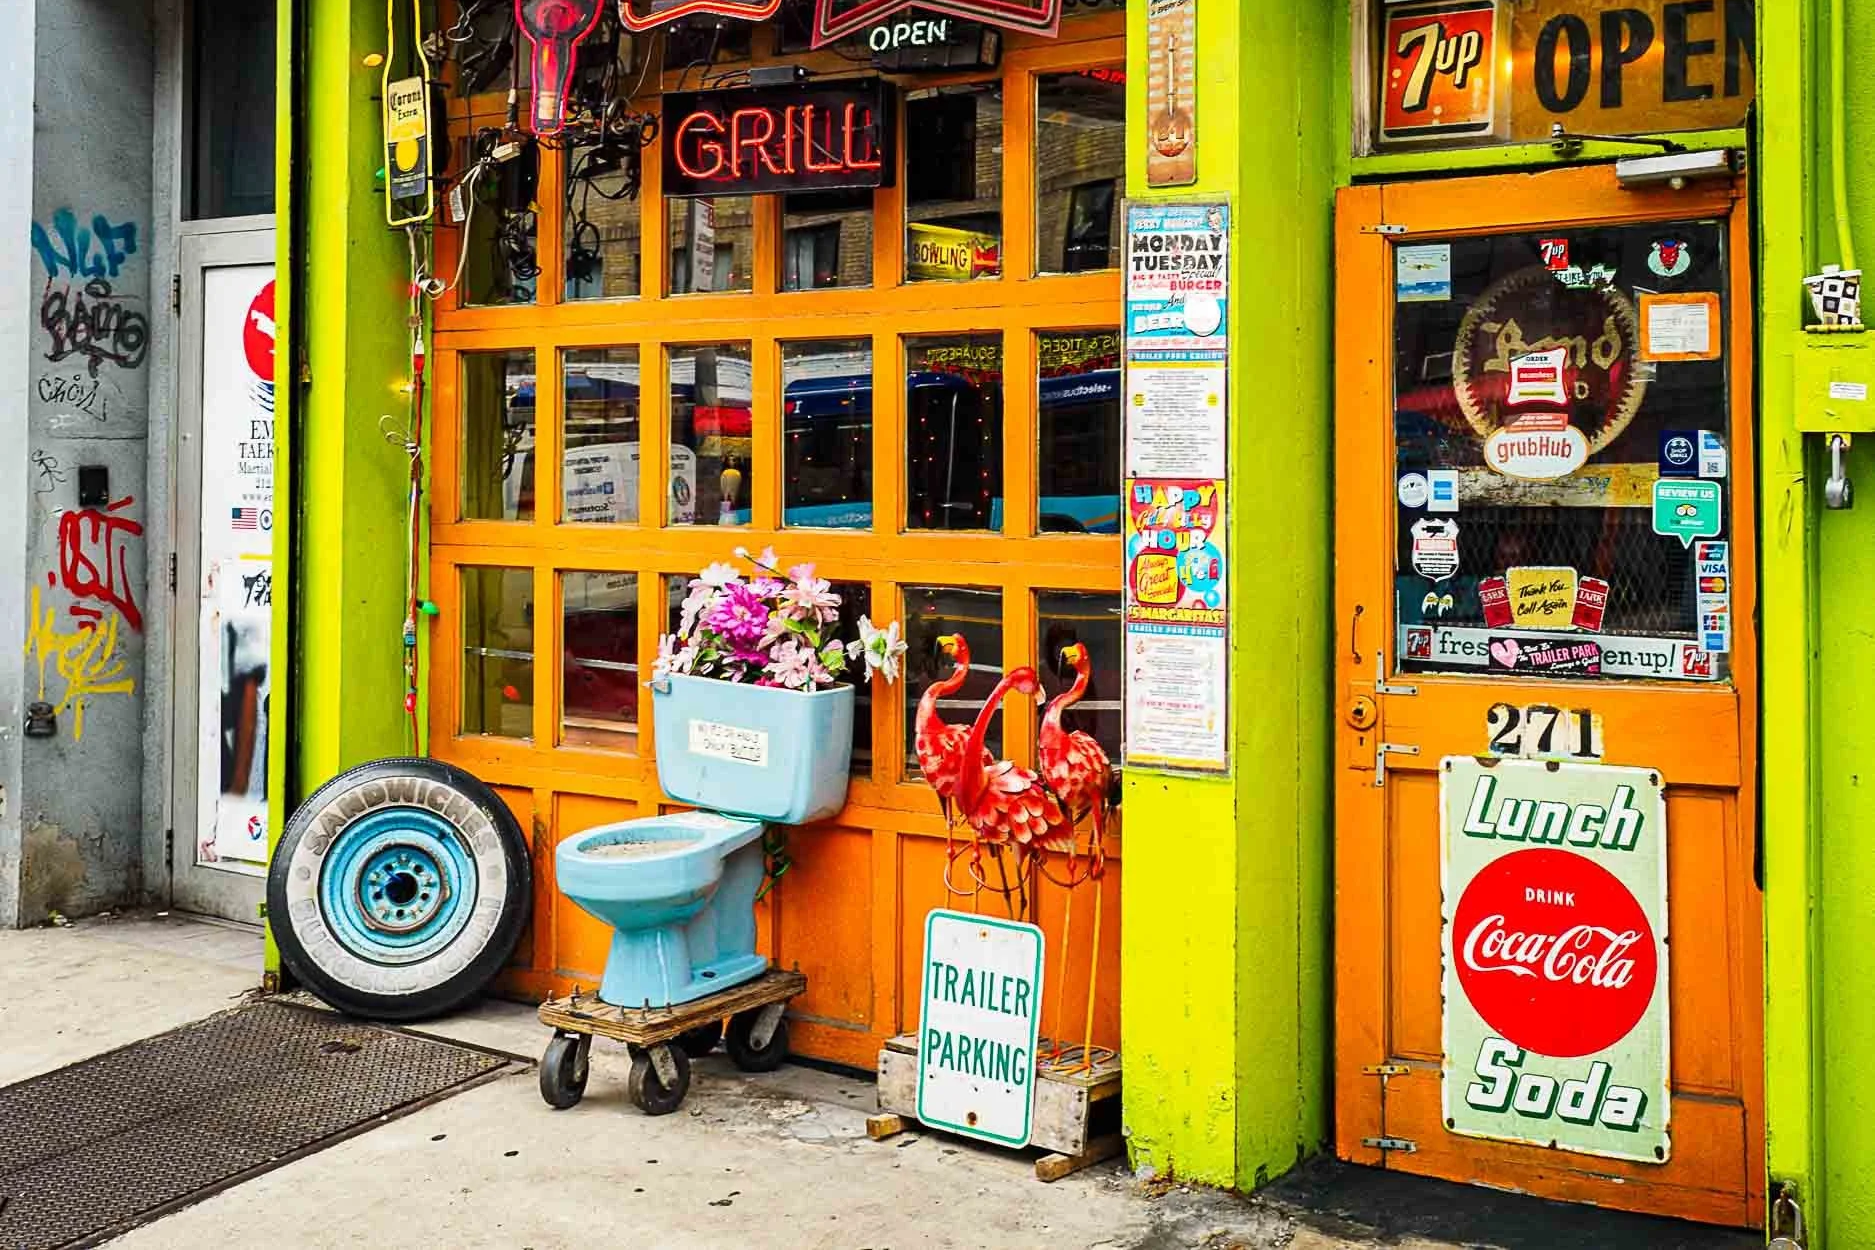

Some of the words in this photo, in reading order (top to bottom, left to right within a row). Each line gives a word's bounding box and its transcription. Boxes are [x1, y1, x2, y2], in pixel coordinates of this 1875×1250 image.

[870, 19, 948, 51] OPEN
[675, 103, 880, 180] GRILL
[913, 242, 967, 268] BOWLING
[1132, 234, 1222, 253] MONDAY
[1132, 254, 1222, 271] TUESDAY
[1170, 280, 1222, 291] BURGER
[251, 420, 275, 439] EM
[239, 442, 275, 458] TAEK
[1498, 436, 1572, 463] grubHub
[1134, 484, 1216, 512] HAPPY
[1140, 529, 1206, 553] HOUR
[1139, 567, 1175, 594] Great
[1701, 564, 1727, 574] VISA
[1519, 583, 1547, 598] Thank
[1517, 601, 1536, 616] Call
[1537, 598, 1568, 615] Again
[1439, 630, 1489, 657] fres
[1530, 648, 1570, 666] TRAILER
[1572, 643, 1599, 659] PARK
[1487, 703, 1602, 758] 271
[1463, 775, 1644, 851] Lunch
[1525, 887, 1576, 907] DRINK
[1463, 914, 1643, 990] Coca-Cola
[931, 961, 1031, 1018] TRAILER
[927, 1028, 1027, 1086] PARKING
[1466, 1037, 1649, 1132] Soda
